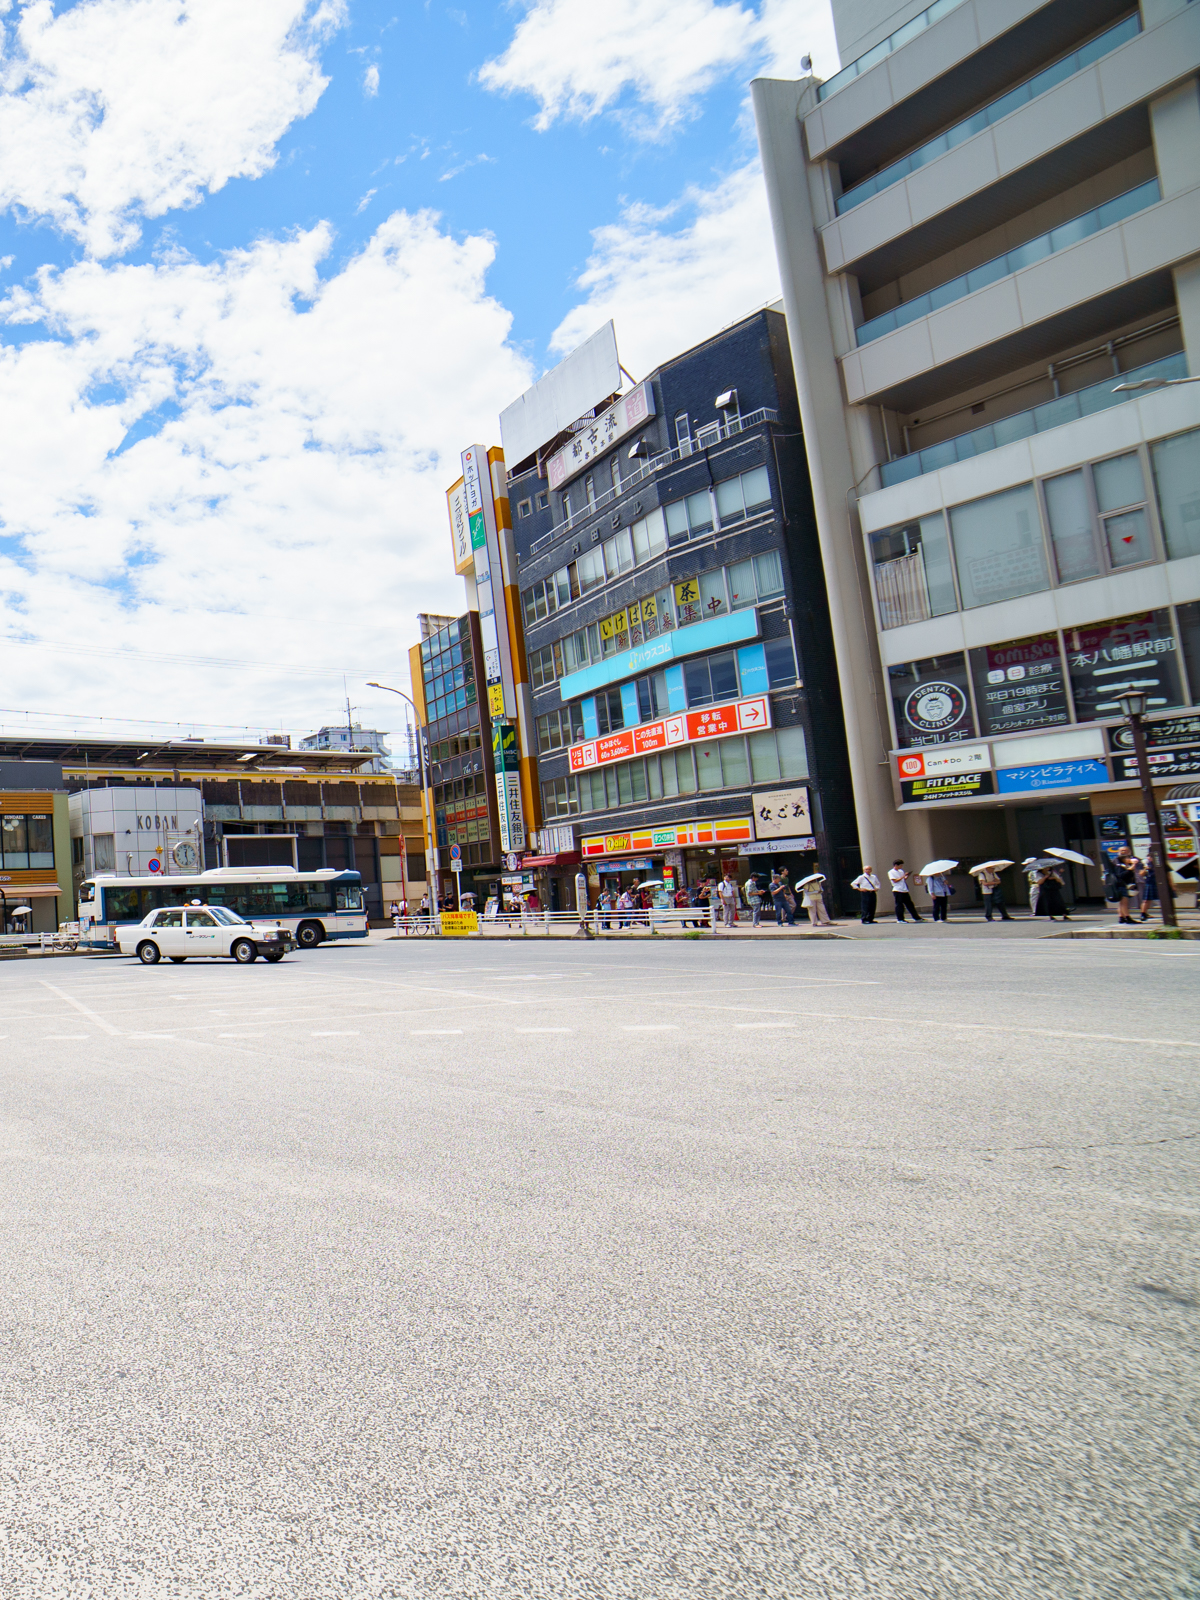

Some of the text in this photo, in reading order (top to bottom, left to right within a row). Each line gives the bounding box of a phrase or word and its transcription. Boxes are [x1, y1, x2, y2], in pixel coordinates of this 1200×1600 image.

[627, 392, 646, 424] 道
[572, 413, 617, 458] 都古流
[551, 459, 565, 484] 花
[467, 465, 477, 507] ホットヨガ
[618, 596, 721, 648] 新会員募集中
[638, 642, 671, 662] ハウスコム
[1070, 636, 1176, 667] 本八幡駅前
[914, 685, 950, 699] DENTAL
[986, 681, 1061, 701] 平日19時まで
[1002, 699, 1047, 715] 個室アリ
[701, 711, 721, 723] 移転
[919, 715, 955, 728] CLINIC
[635, 725, 663, 740] この先直進
[697, 721, 728, 735] 営業中
[642, 739, 658, 748] 100m
[949, 730, 968, 742] 2F
[600, 738, 621, 750] もみほぐし
[905, 760, 918, 770] 100
[968, 754, 982, 762] 2階
[1006, 763, 1097, 779] マシンピラティス
[926, 774, 981, 787] FIT PLACE
[507, 776, 523, 845] 三井住友銀行
[137, 815, 177, 830] KOBAN
[606, 837, 629, 851] Daily
